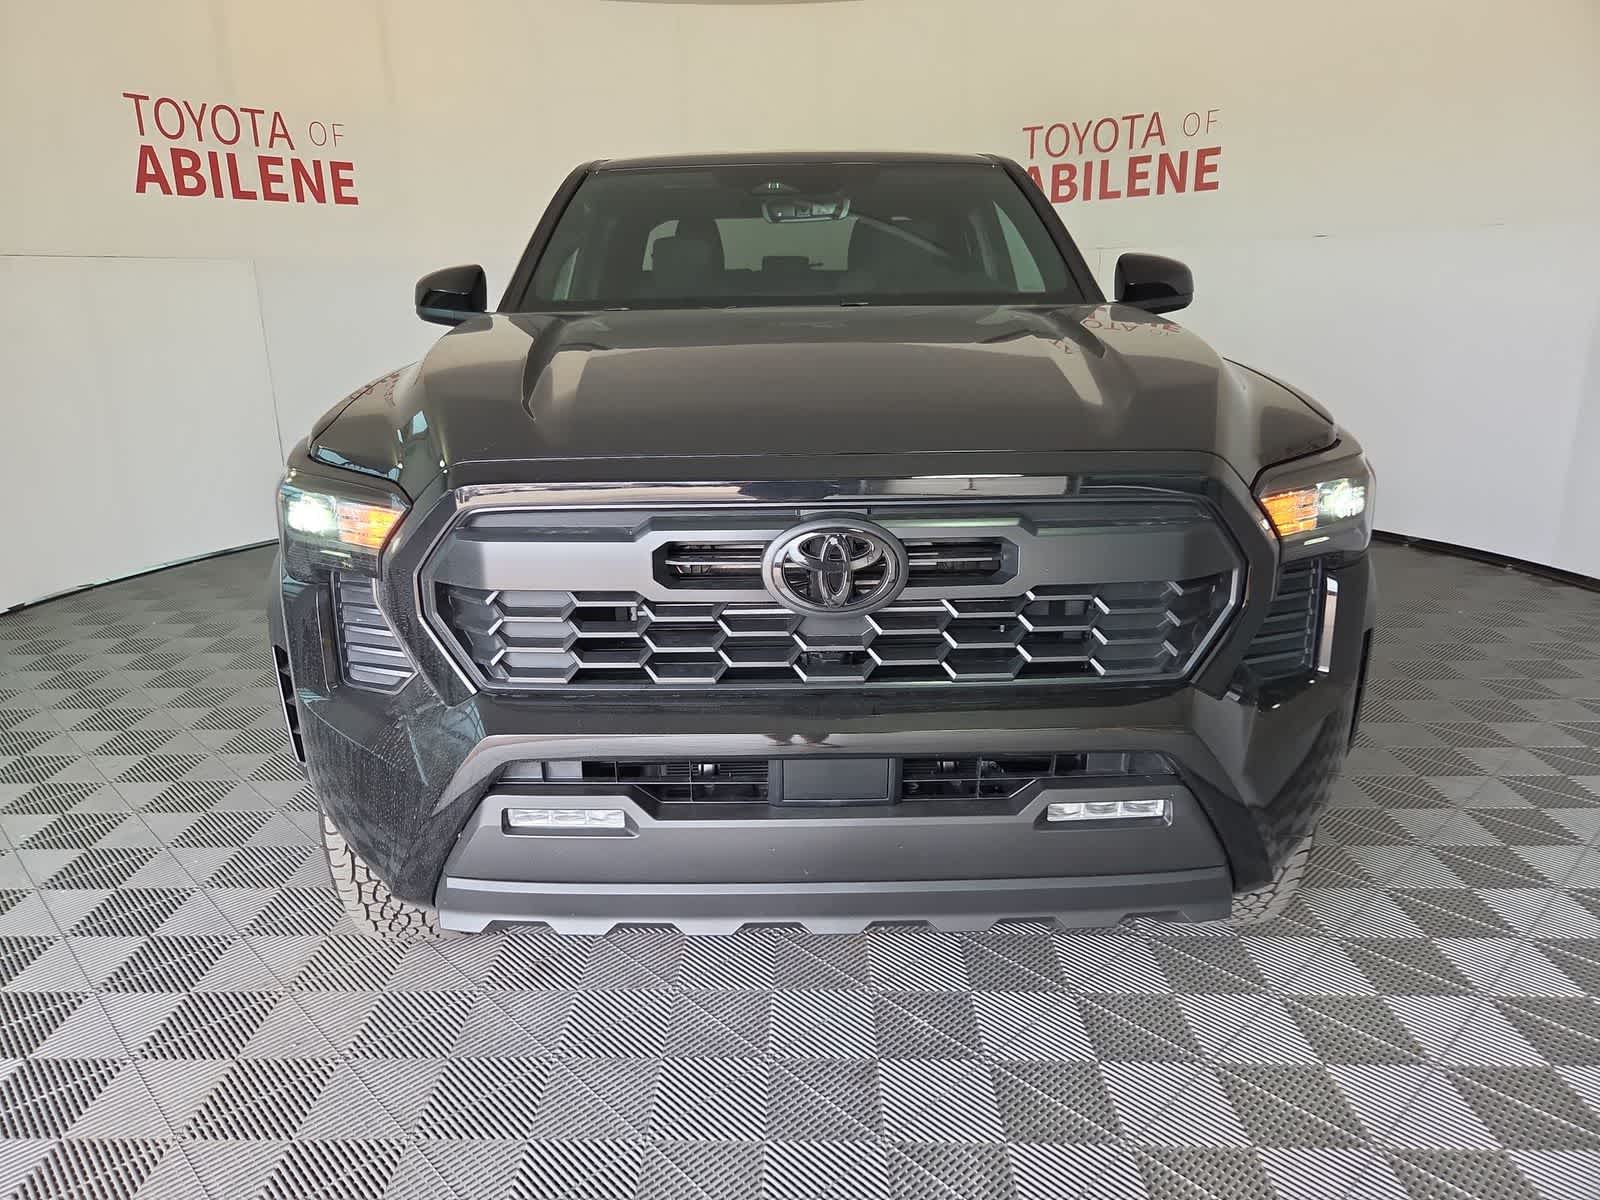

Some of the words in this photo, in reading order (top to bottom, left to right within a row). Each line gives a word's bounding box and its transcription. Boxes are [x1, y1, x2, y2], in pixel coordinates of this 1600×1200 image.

[123, 93, 294, 150] TOYOTA
[309, 121, 345, 147] OF
[1022, 111, 1166, 160] TOYOTA
[1183, 109, 1221, 136] OF
[135, 145, 359, 206] ABILENE
